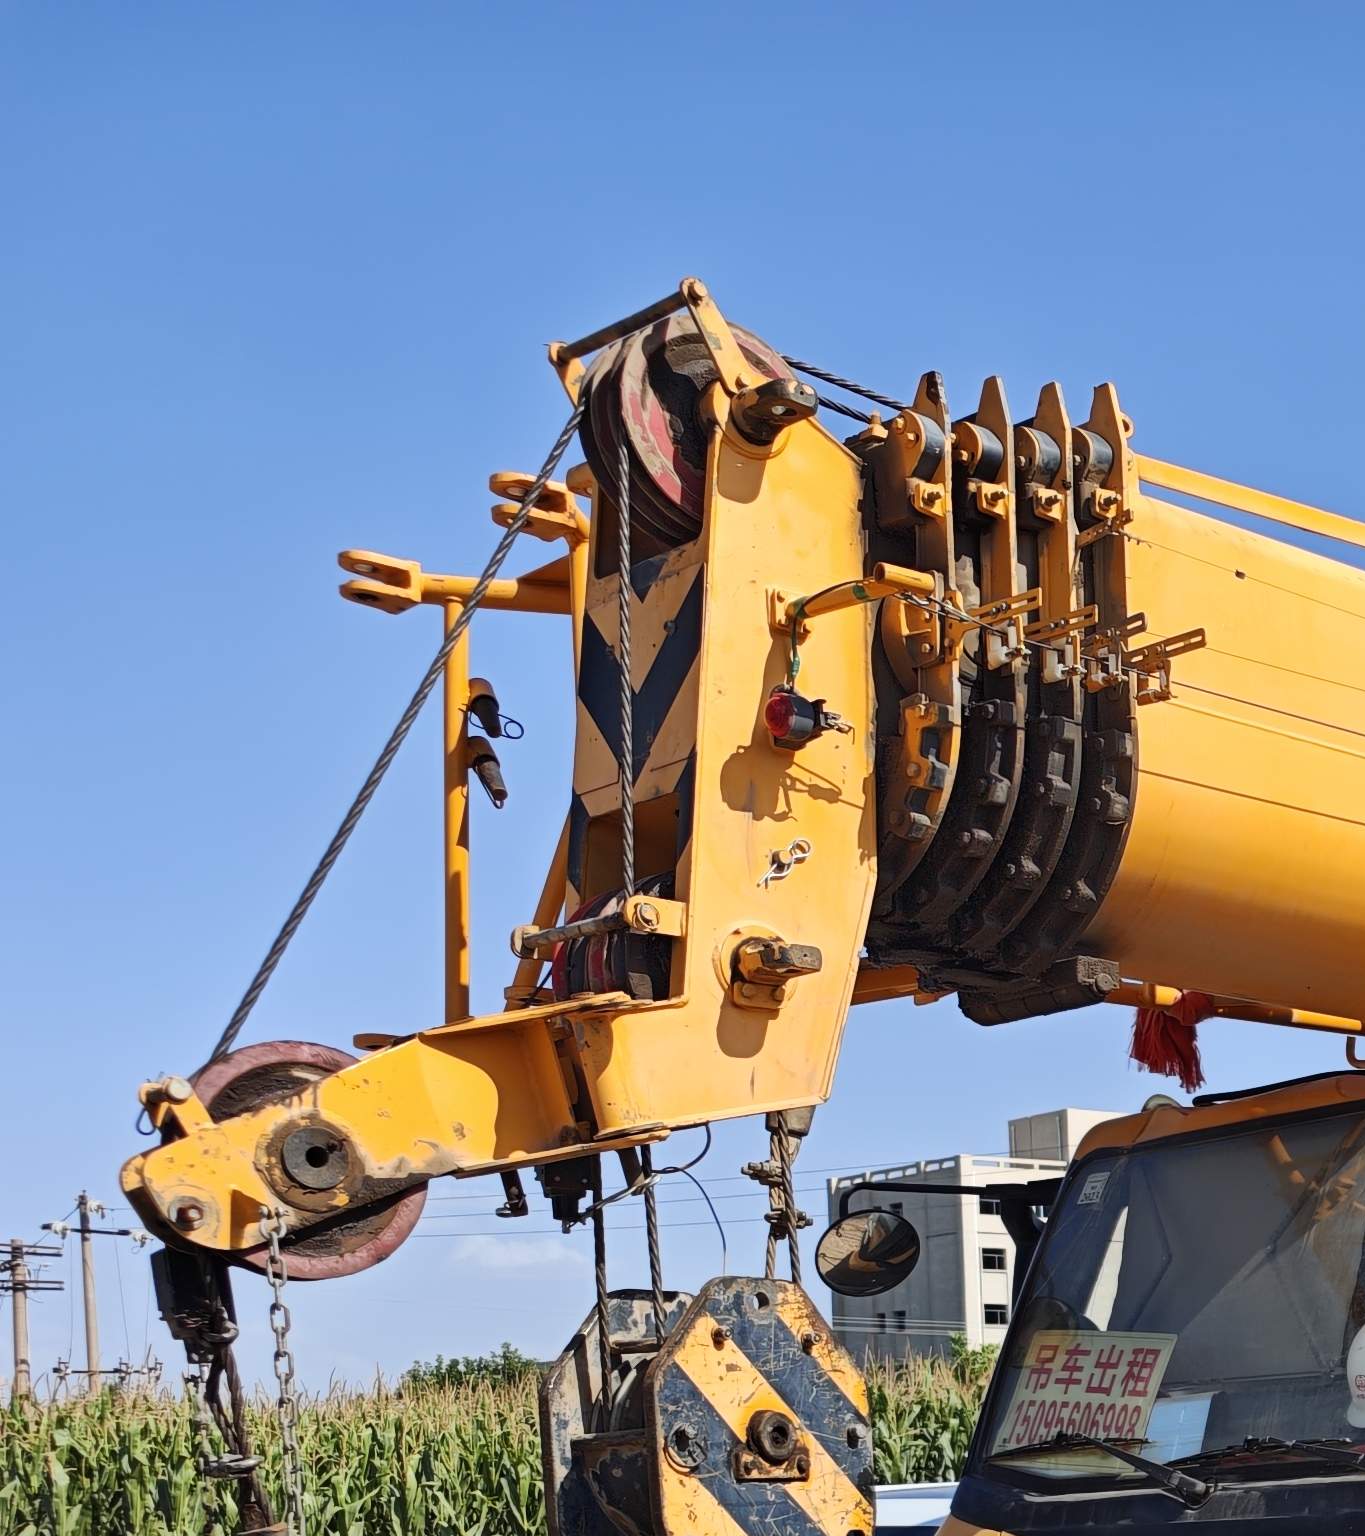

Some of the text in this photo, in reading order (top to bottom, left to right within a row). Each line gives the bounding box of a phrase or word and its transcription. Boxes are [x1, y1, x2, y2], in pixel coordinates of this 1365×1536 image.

[1025, 1343, 1162, 1398] 吊车出租
[1008, 1400, 1142, 1445] 15095606998
